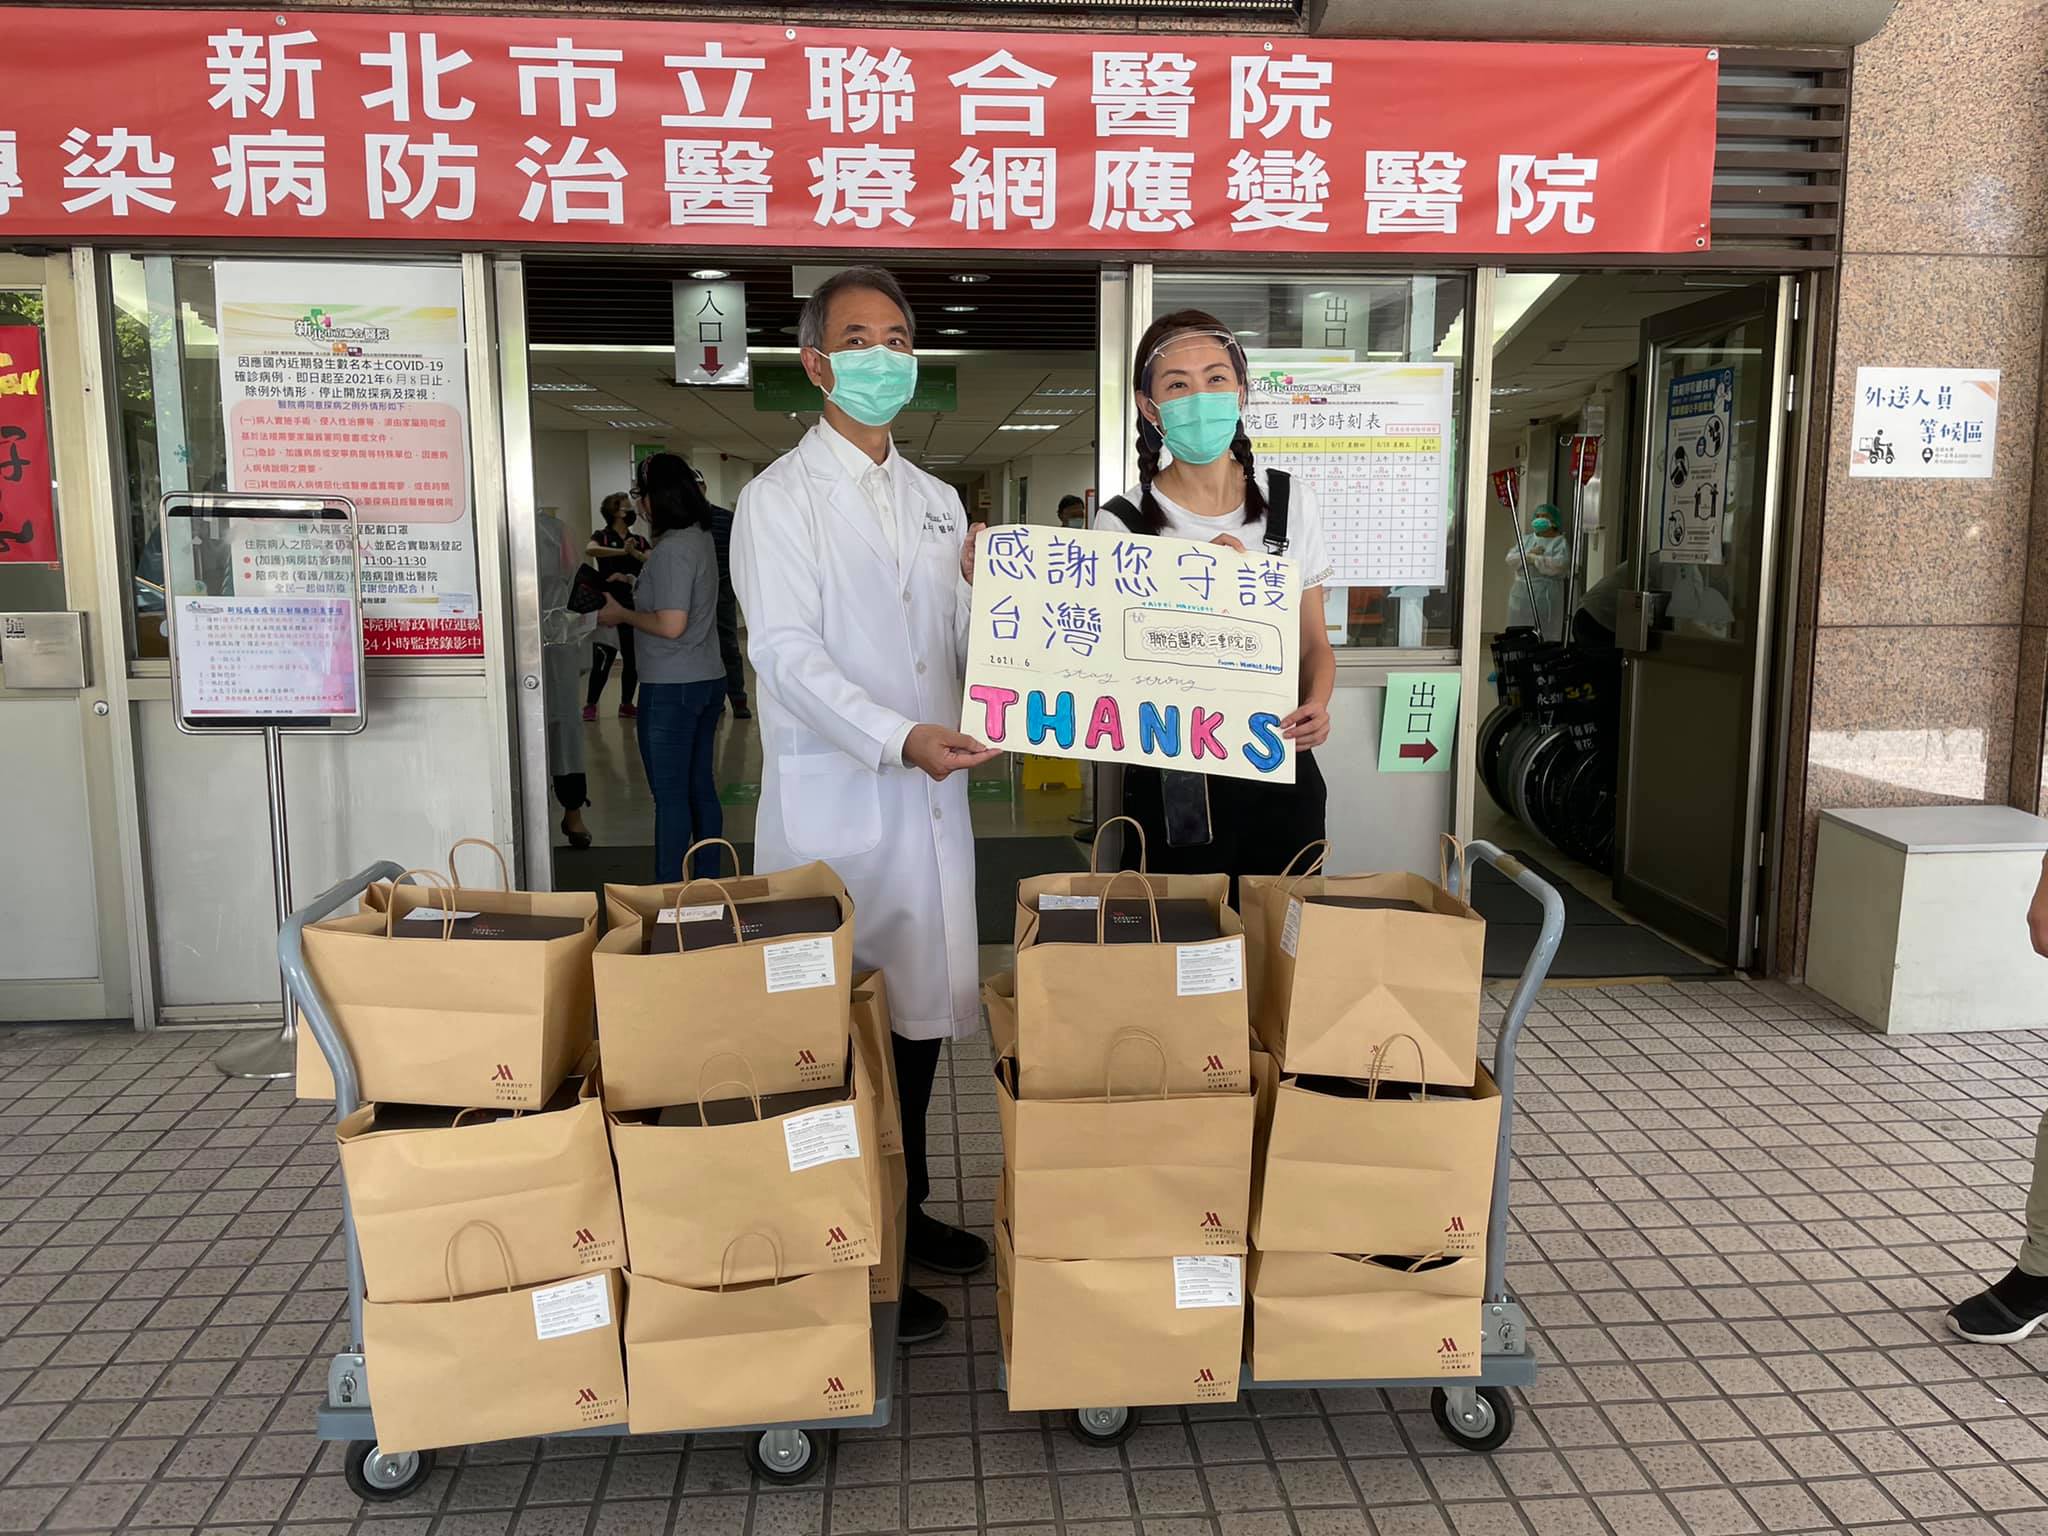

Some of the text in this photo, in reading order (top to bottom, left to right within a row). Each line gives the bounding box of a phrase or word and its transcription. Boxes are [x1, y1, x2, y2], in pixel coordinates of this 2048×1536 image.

[207, 28, 1334, 140] 新北市立聯合醫院
[0, 127, 1599, 236] 染病防治醫療網應變醫院
[696, 290, 724, 343] 入口
[1324, 297, 1349, 348] 出口
[1291, 411, 1382, 431] 門診時刻表
[1865, 385, 1952, 410] 外送人員
[1919, 418, 1984, 445] 等候區
[987, 527, 1289, 612] 感謝您守護
[989, 595, 1102, 658] 台灣
[969, 684, 1287, 774] THANKS
[1407, 681, 1436, 733] 出口
